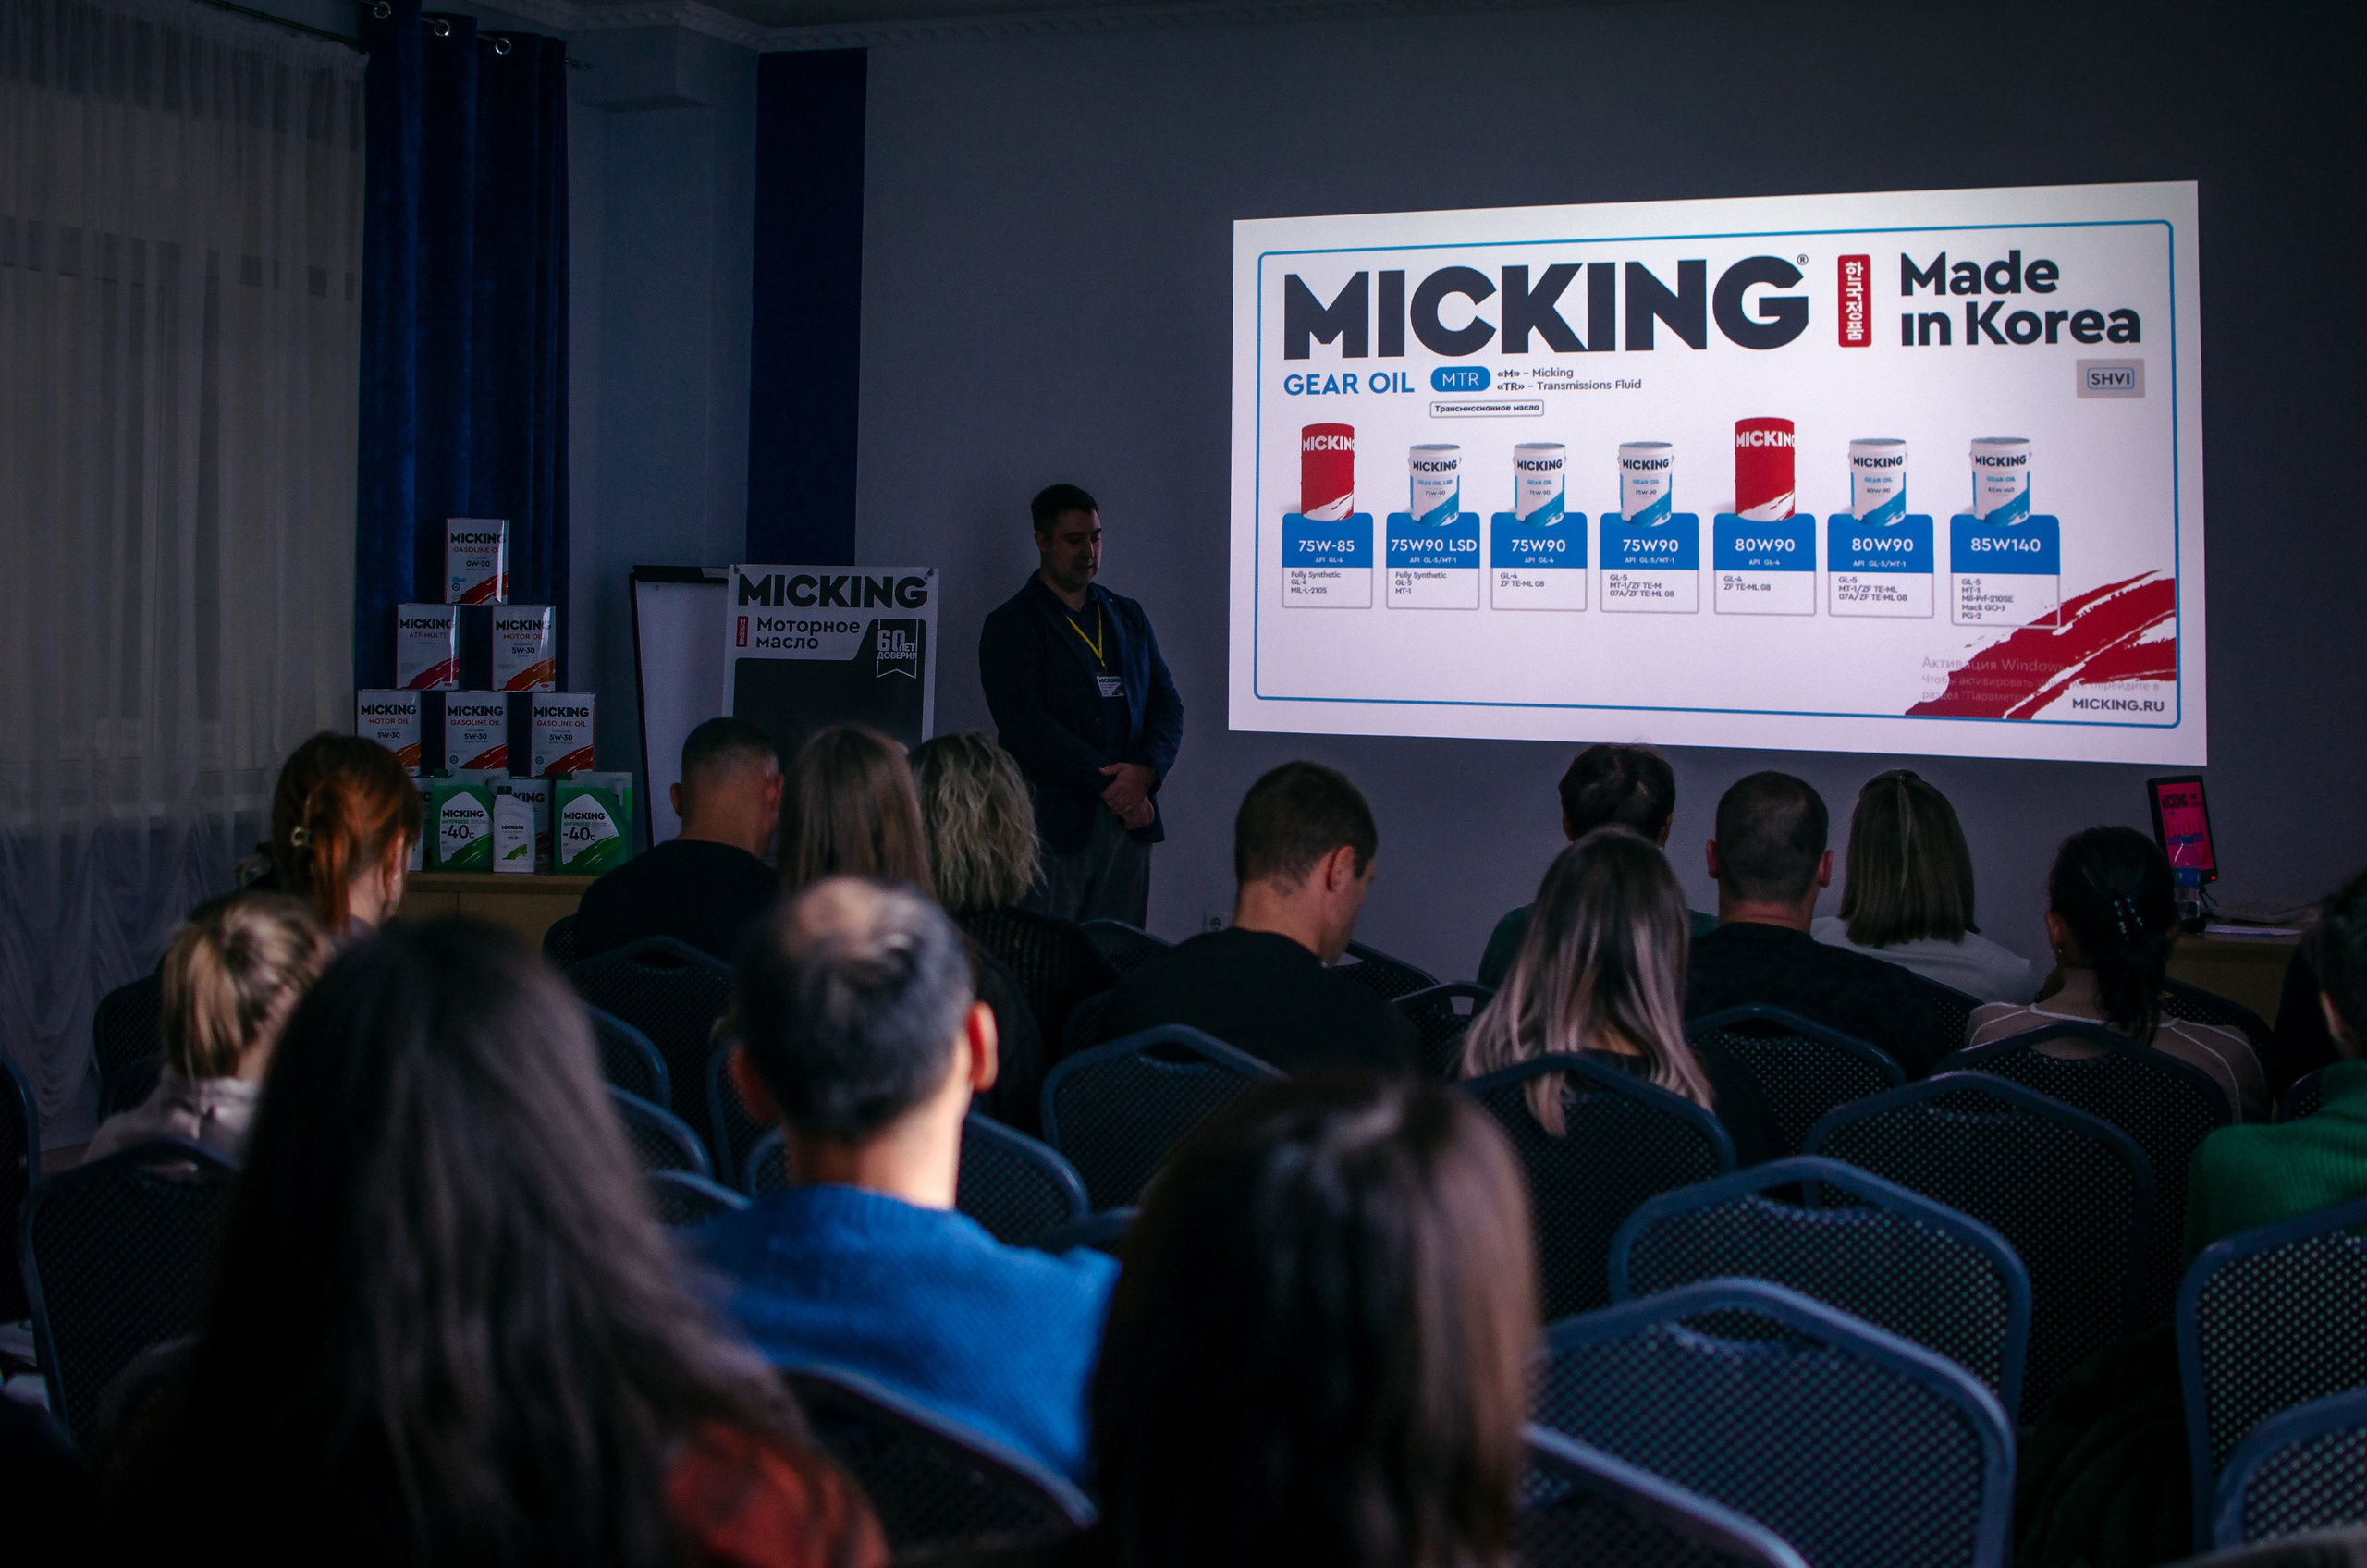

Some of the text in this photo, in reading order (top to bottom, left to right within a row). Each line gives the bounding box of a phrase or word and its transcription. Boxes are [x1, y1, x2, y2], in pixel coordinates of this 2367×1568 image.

[1901, 250, 2060, 297] Made
[1846, 261, 1864, 341] 한국정품
[1901, 300, 2141, 347] in Korea
[1441, 372, 1479, 387] MTR
[1497, 369, 1521, 378] «M»
[1532, 368, 1574, 379] Micking
[2091, 372, 2131, 386] SHVI
[1284, 372, 1416, 397] GEAR OIL
[1497, 382, 1525, 392] «TR»
[1537, 380, 1612, 391] Transmissions
[1615, 379, 1642, 389] Fluid
[1434, 403, 1539, 414] Трансмиссионное масло
[1412, 460, 1457, 472] MICKING
[1517, 459, 1563, 472] MICKING
[1622, 459, 1670, 472] MICKING
[1853, 456, 1904, 469] MICKING
[1975, 454, 2027, 468] MICKING
[1298, 539, 1355, 553] 75W-85
[1391, 539, 1478, 552] 75W90 LSD
[1511, 539, 1566, 553] 75W90
[1623, 539, 1679, 553] 75W90
[1735, 538, 1796, 553] 80W90
[1852, 538, 1914, 553] 80W90
[1971, 537, 2042, 553] 85W140
[1291, 570, 1341, 580] Fully Synthetic
[1395, 571, 1447, 580] Fully Synthetic
[1723, 575, 1742, 583] GL-4
[1760, 583, 1772, 592] 08
[1961, 578, 1981, 586] GL-5
[738, 574, 928, 609] MICKING
[1874, 585, 1898, 594] TE-ML
[1961, 586, 1981, 594] MT-1
[1871, 594, 1895, 602] TE-ML
[1961, 604, 1982, 612] Mack
[1961, 612, 1981, 620] PG-2
[756, 617, 861, 636] Моторное
[756, 635, 819, 649] масло
[877, 629, 916, 652] 60 ЛЕТ
[877, 651, 918, 660] ДОВЕРИЯ
[361, 704, 416, 716] MICKING
[448, 705, 504, 717] MICKING
[2072, 697, 2165, 712] MICKING.RU
[533, 706, 589, 717] MICKING
[442, 810, 484, 818] MICKING
[563, 812, 606, 820] MICKING
